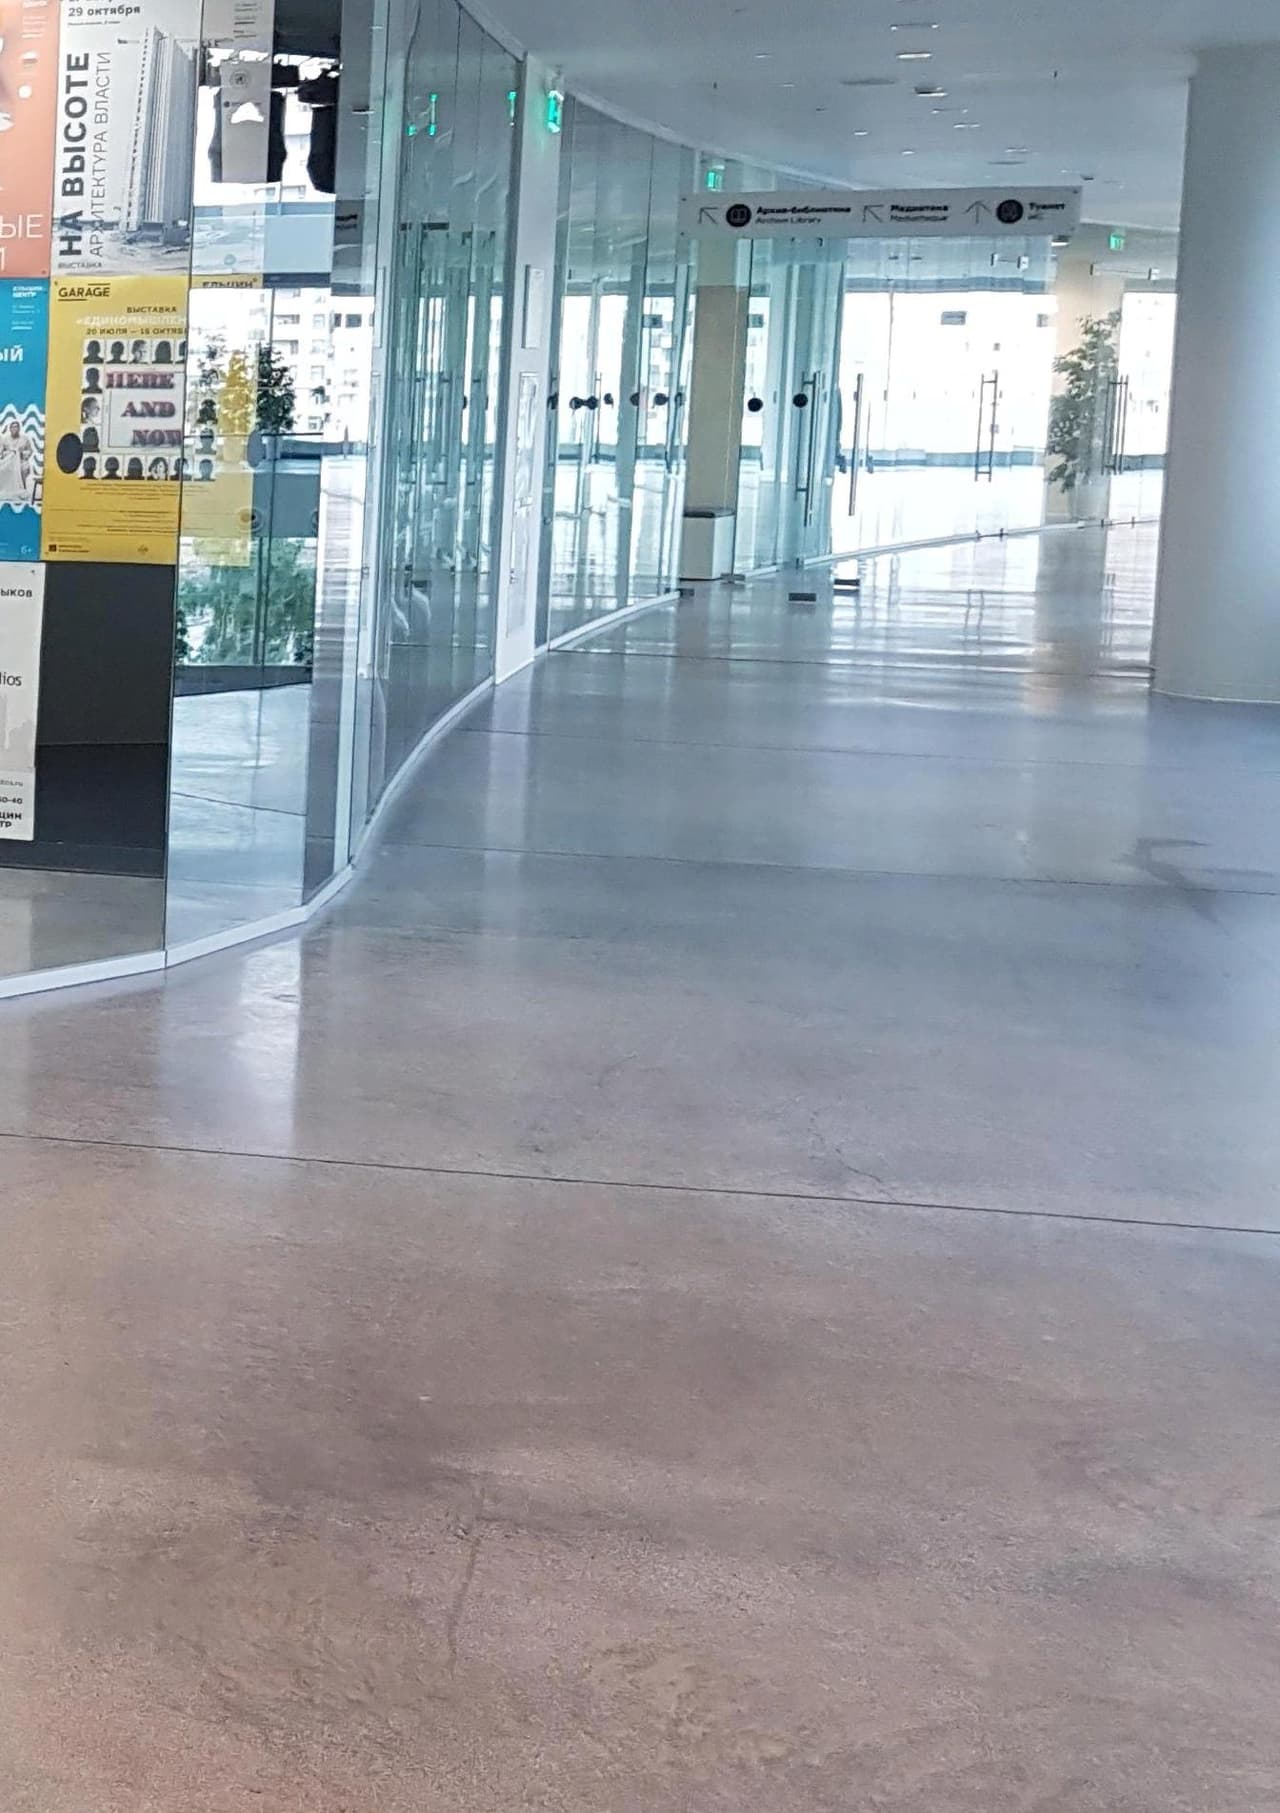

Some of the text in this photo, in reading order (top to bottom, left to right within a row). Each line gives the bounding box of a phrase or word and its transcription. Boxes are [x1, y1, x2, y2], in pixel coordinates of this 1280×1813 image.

[68, 5, 141, 18] 29 октября
[59, 53, 89, 256] НА ВЫСОТЕ
[89, 52, 112, 257] АРХИТЕКТУРА ВЛАСТИ
[58, 287, 111, 298] GARAGE
[106, 372, 175, 389] HERE
[121, 401, 176, 417] AND
[131, 429, 182, 447] NOW
